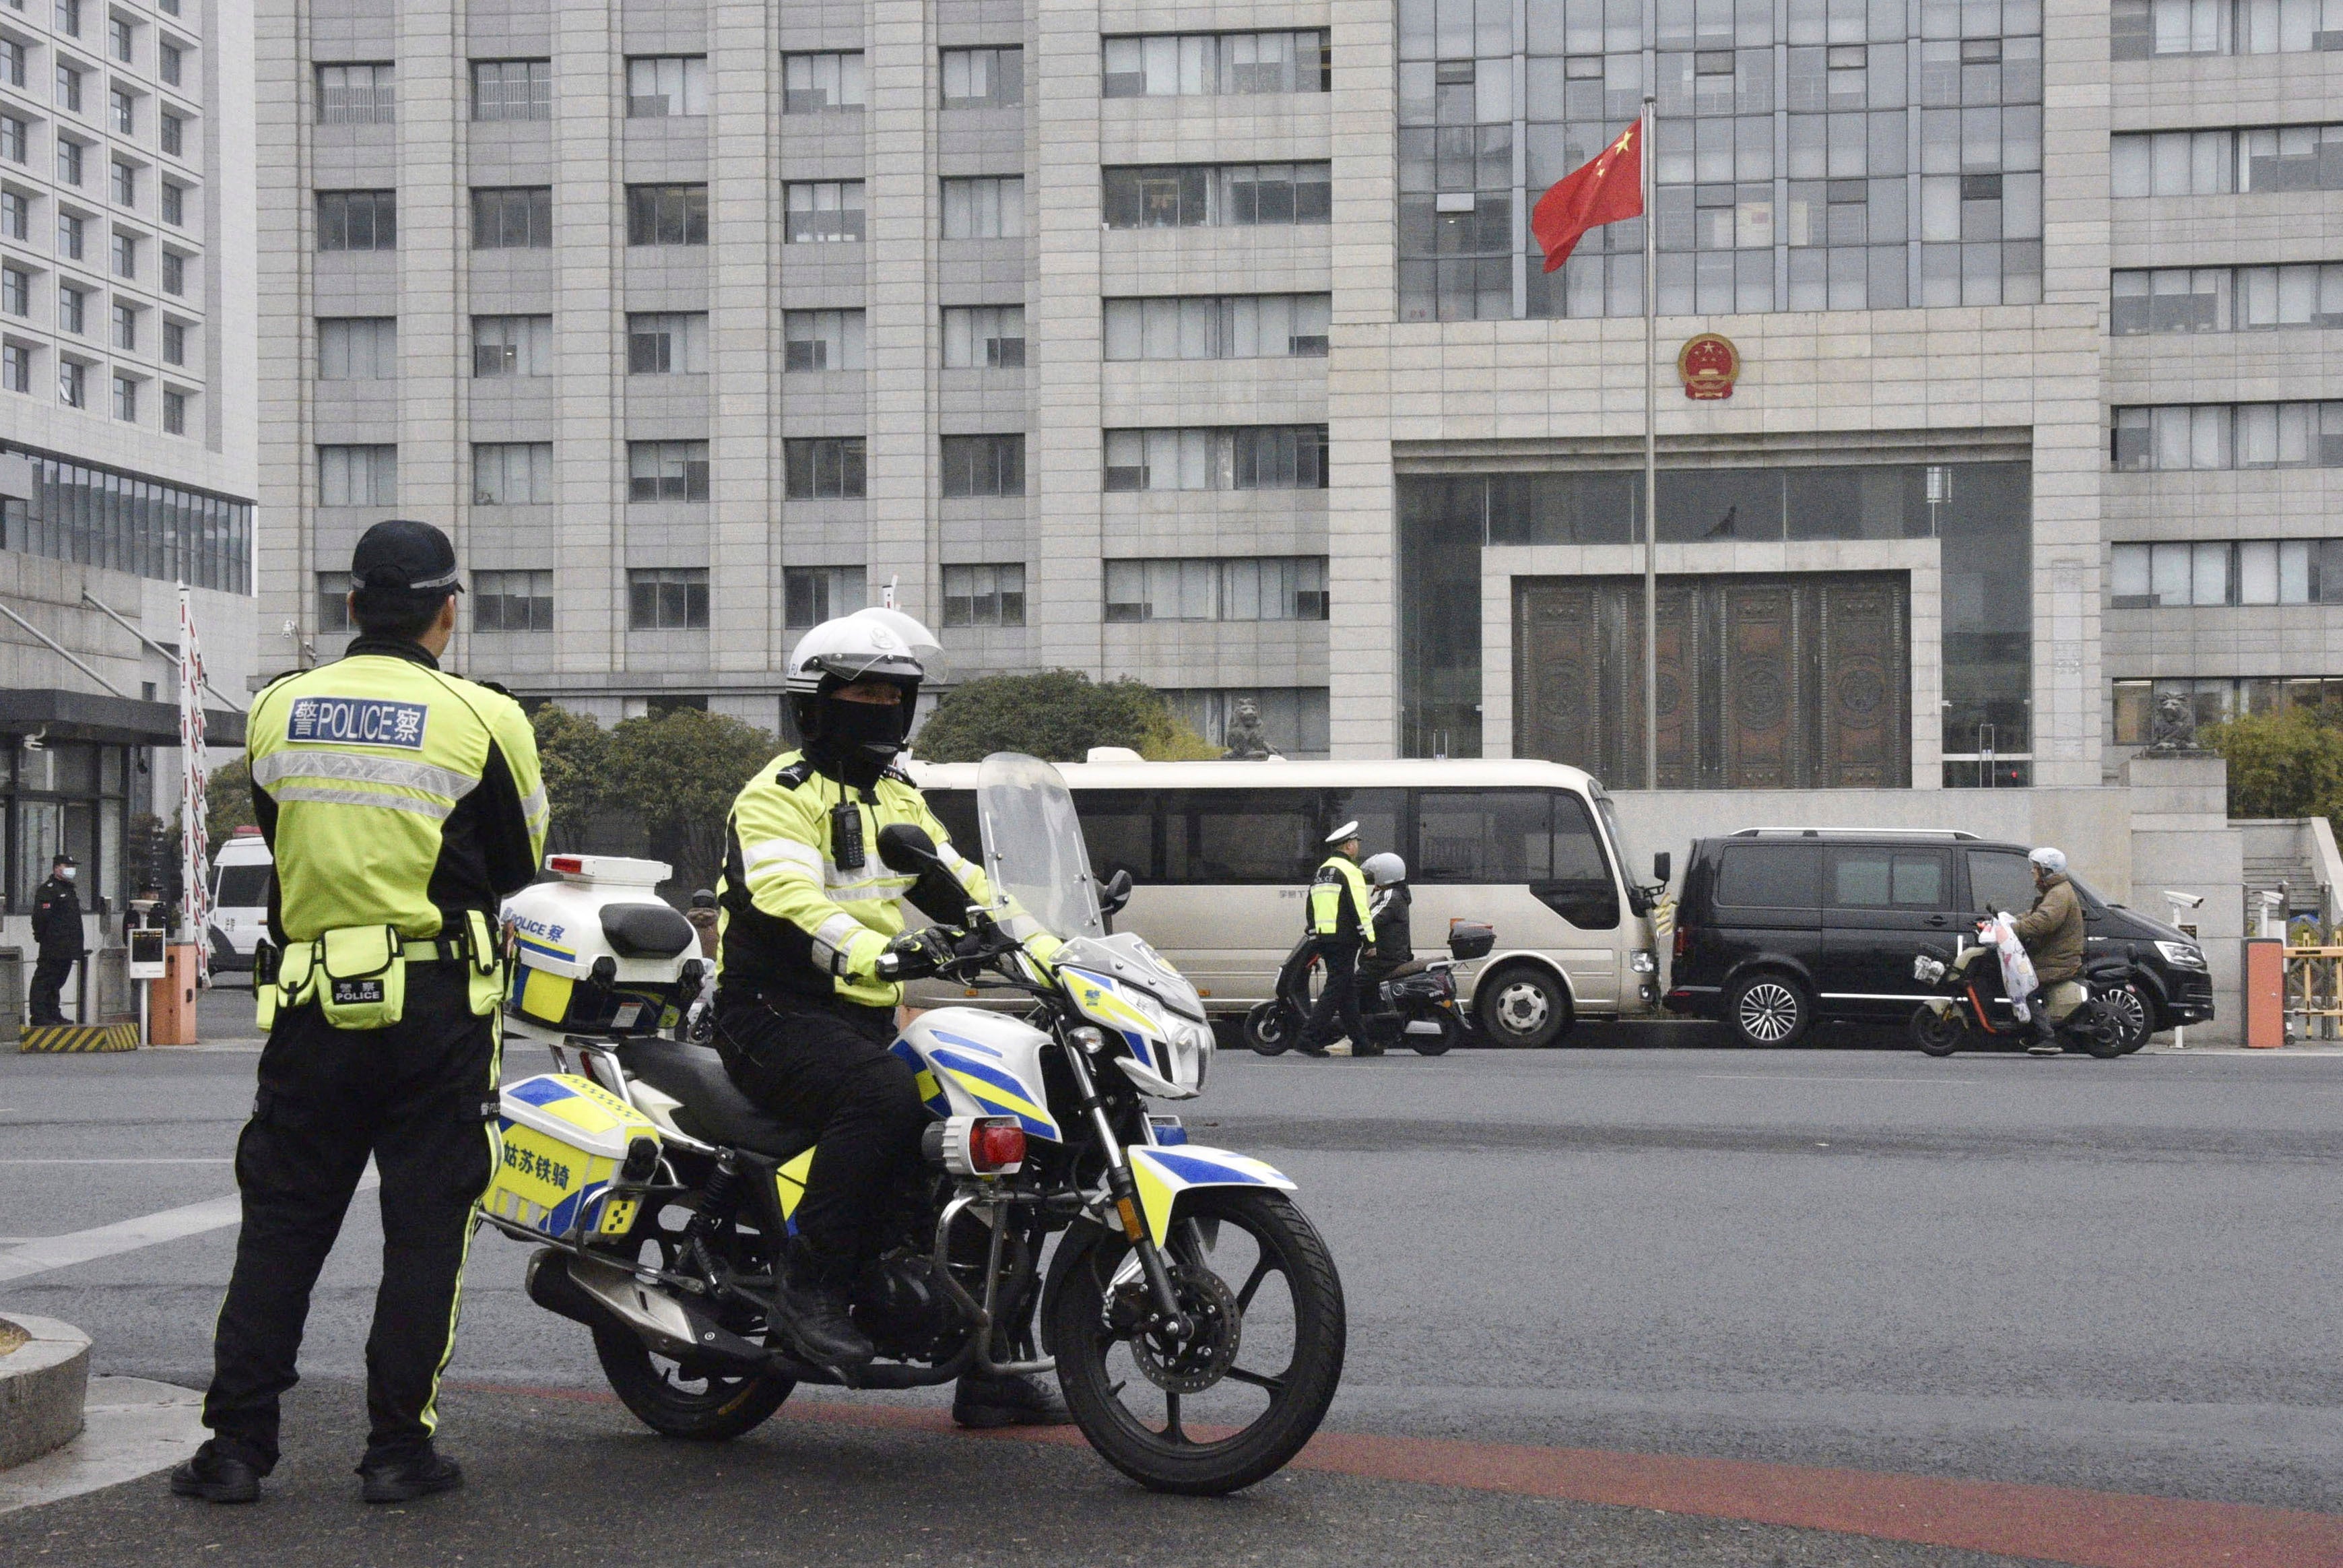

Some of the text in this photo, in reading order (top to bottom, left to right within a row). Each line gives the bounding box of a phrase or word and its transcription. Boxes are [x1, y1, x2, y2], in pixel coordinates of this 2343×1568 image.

[317, 703, 395, 740] POLICE
[335, 991, 380, 1001] POLICE
[504, 1140, 570, 1191] 姑苏铁骑
